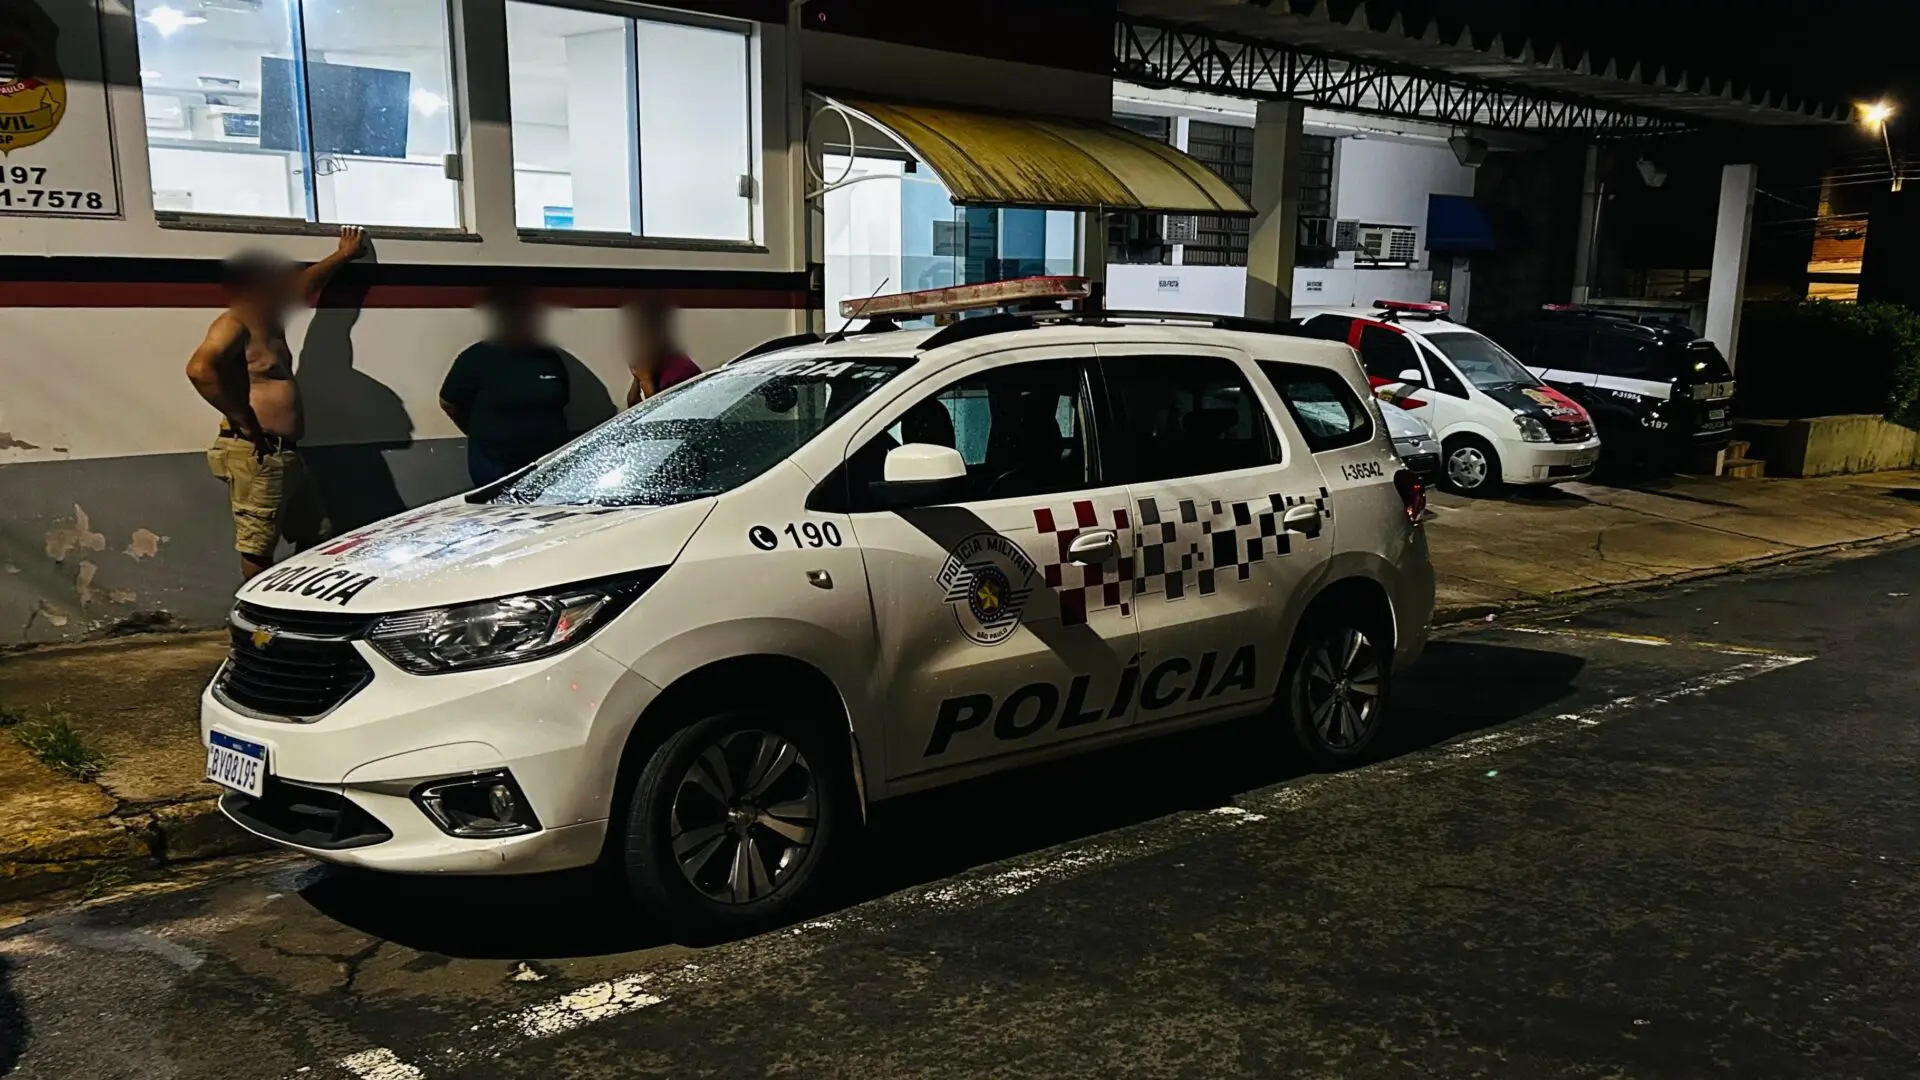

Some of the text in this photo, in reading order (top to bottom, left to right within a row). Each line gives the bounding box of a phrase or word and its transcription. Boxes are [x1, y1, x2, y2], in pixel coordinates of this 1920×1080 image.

[0, 82, 25, 94] AULO
[1341, 461, 1384, 481] I-36542
[784, 521, 842, 549] 190
[987, 537, 1030, 577] MILITAR
[990, 627, 1008, 640] PAULO
[923, 645, 1256, 758] POLÍCIA
